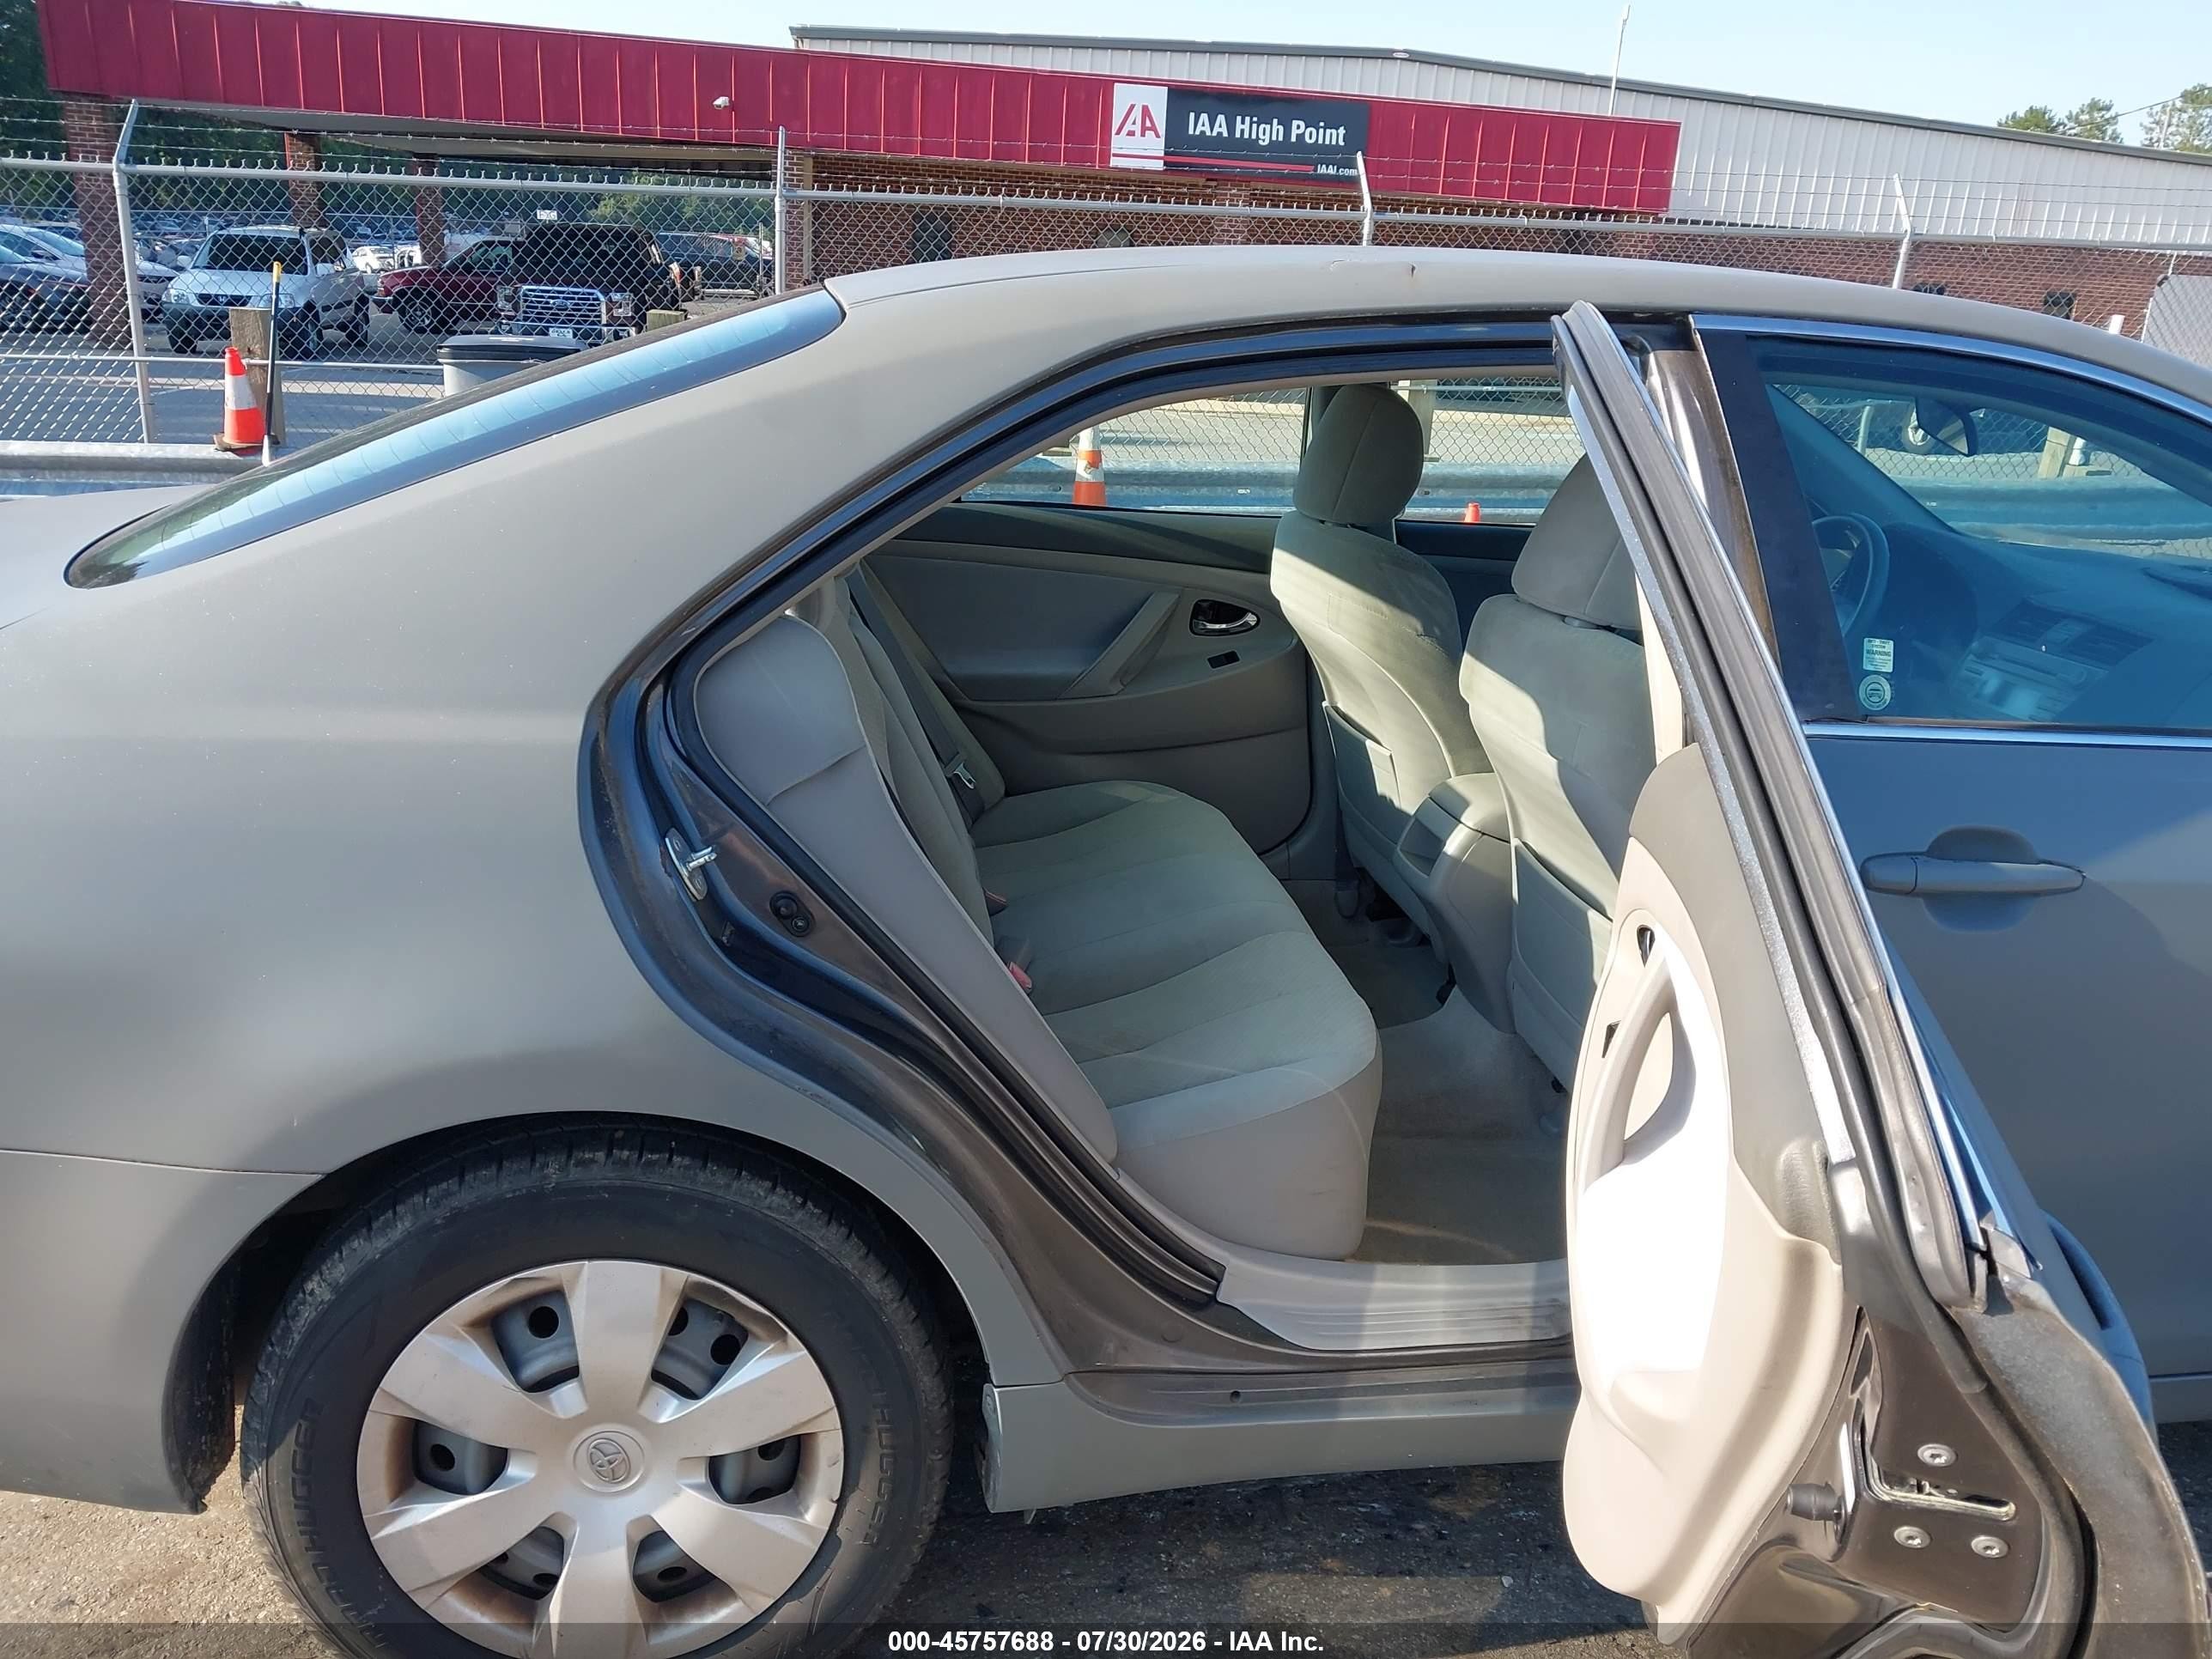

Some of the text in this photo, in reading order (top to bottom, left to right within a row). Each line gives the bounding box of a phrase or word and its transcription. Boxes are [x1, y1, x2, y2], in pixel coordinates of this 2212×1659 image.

[1188, 112, 1346, 146] IAA High Point
[1316, 163, 1358, 176] IAAI.com
